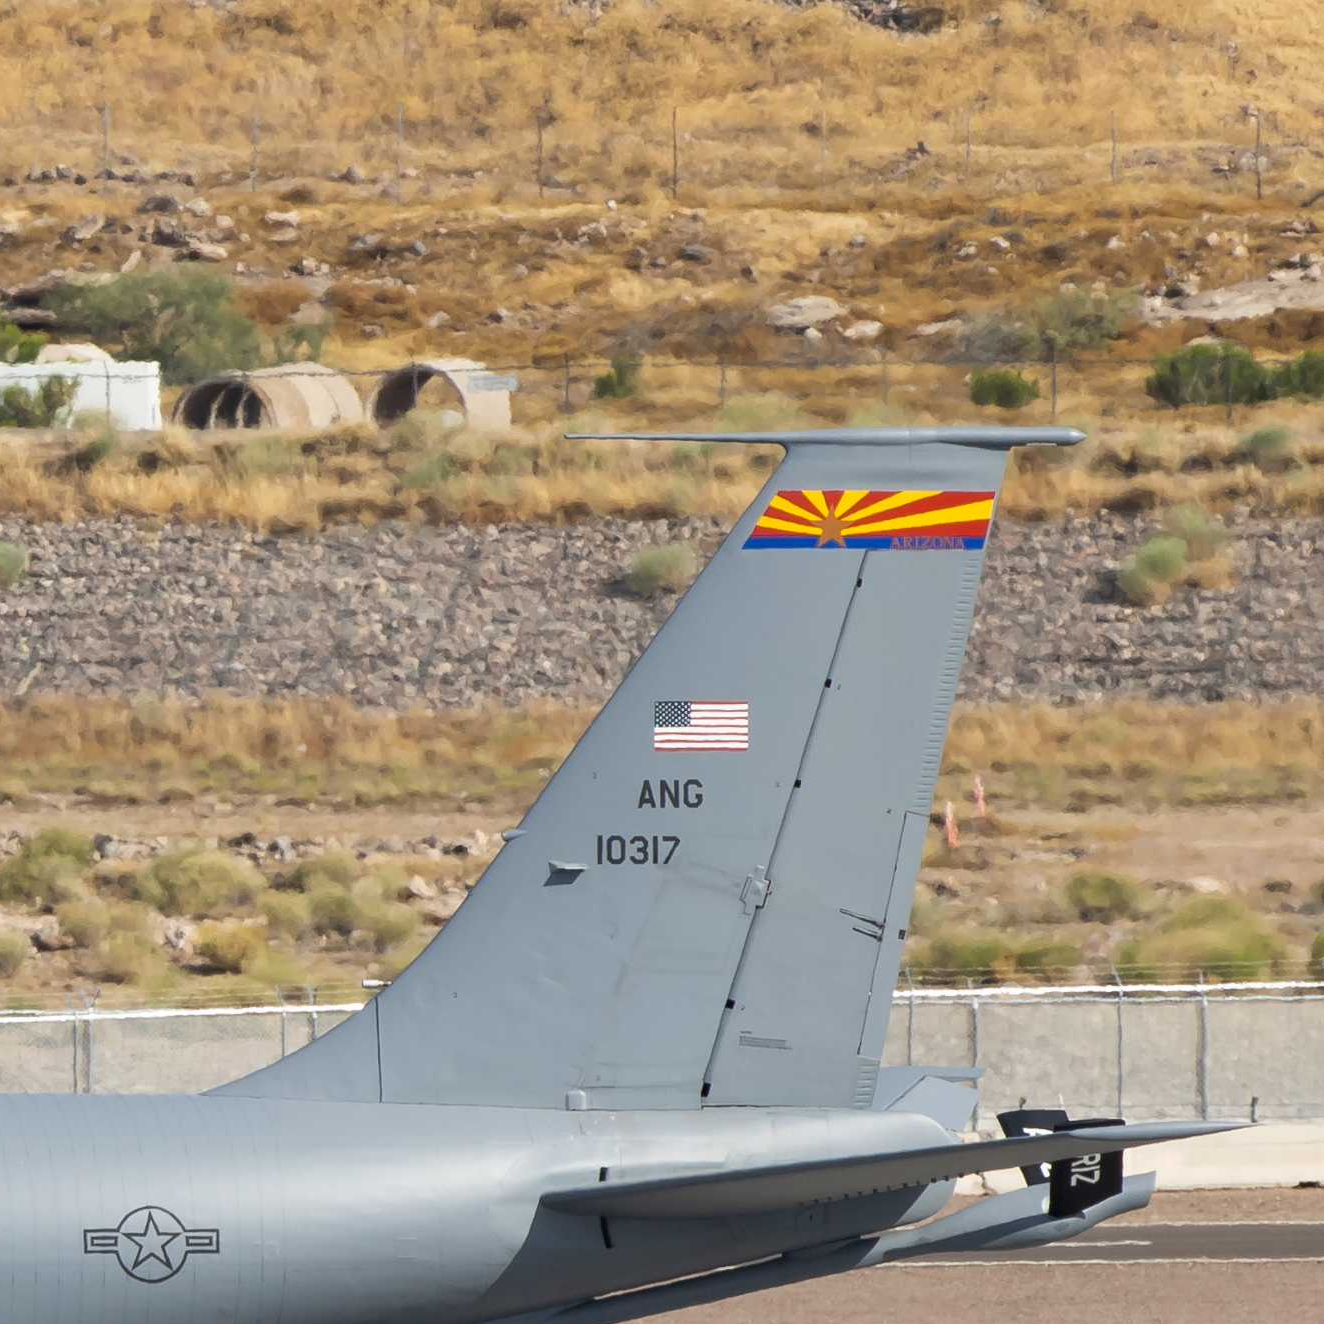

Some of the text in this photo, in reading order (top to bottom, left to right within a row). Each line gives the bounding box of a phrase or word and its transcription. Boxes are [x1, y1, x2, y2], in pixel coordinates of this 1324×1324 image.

[889, 536, 966, 550] ARIZONA
[637, 778, 704, 809] ANG
[596, 834, 681, 865] 10317
[1070, 1153, 1101, 1187] RIZ
